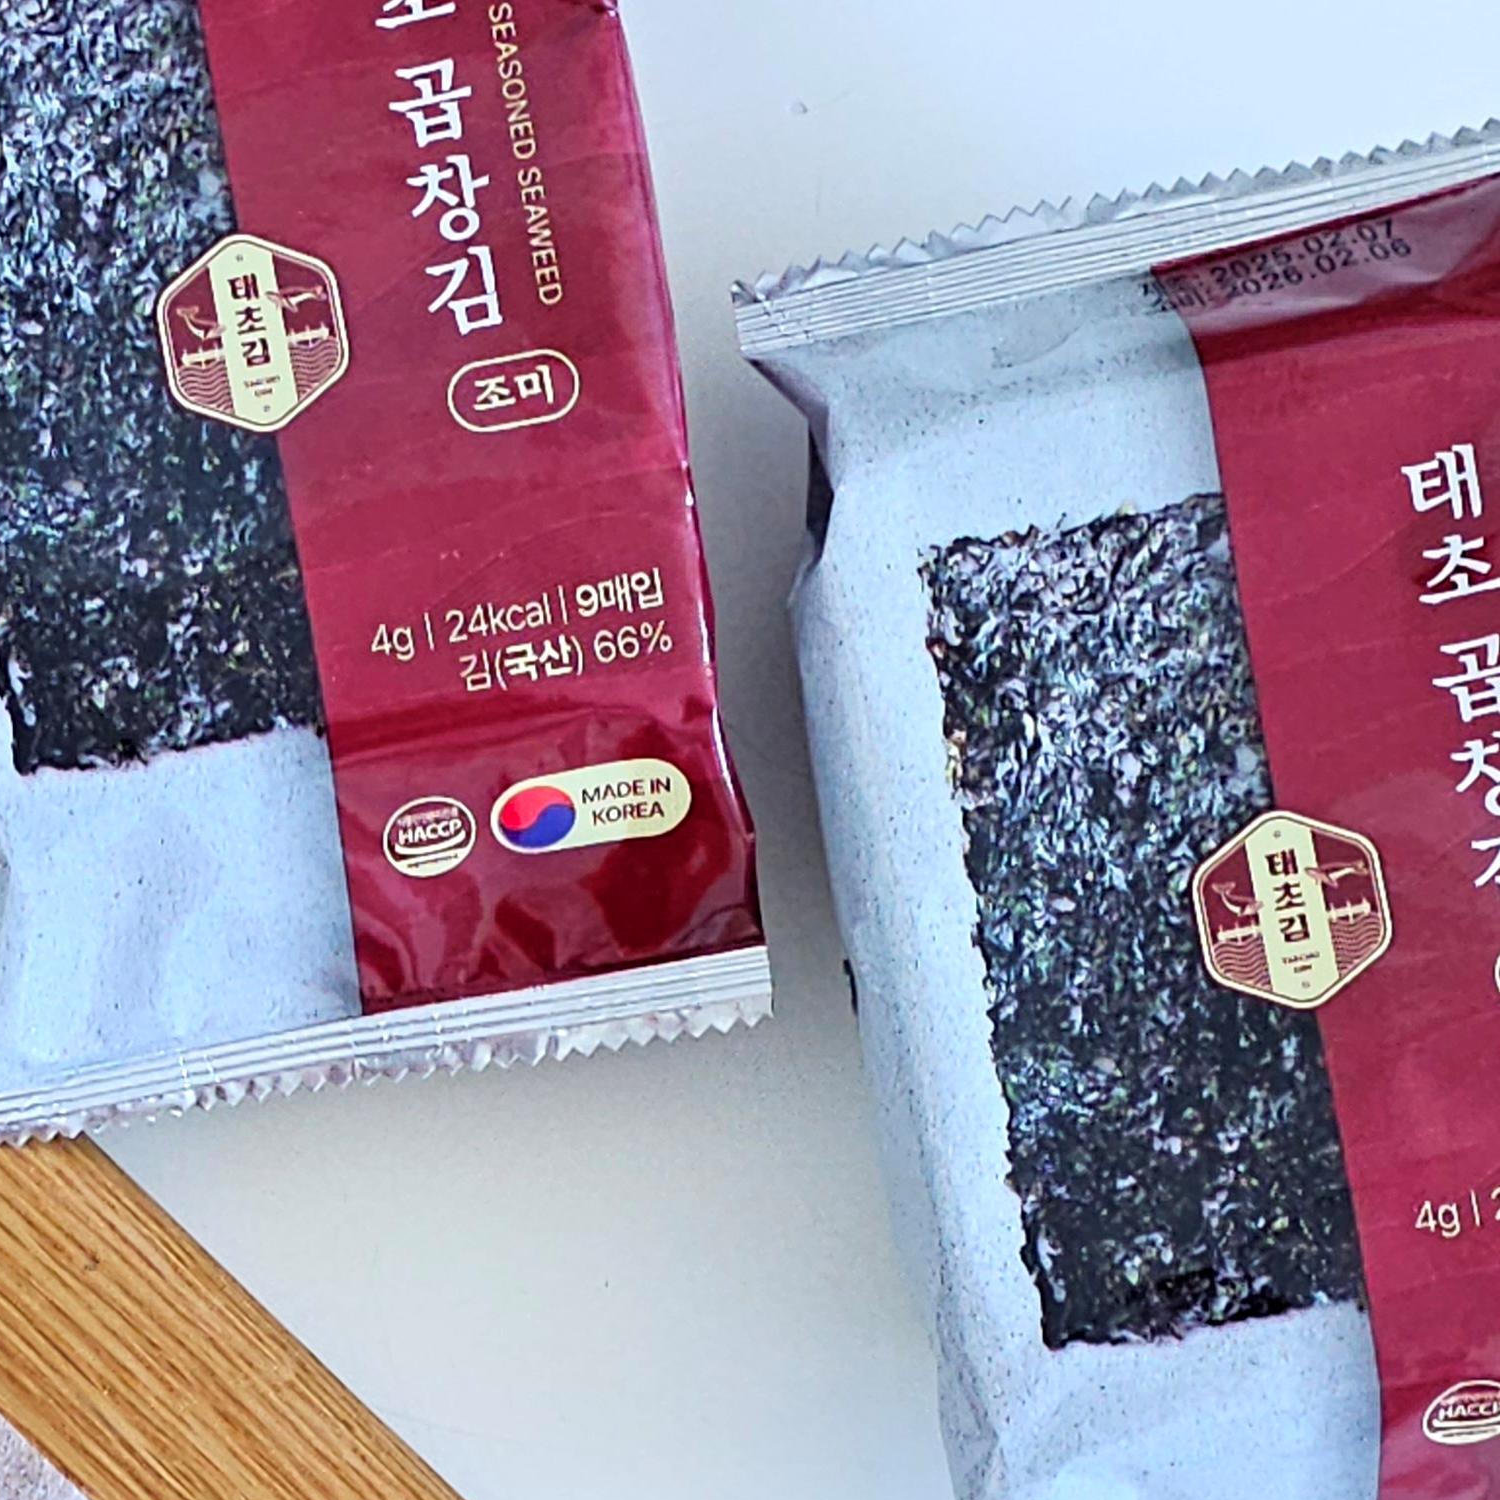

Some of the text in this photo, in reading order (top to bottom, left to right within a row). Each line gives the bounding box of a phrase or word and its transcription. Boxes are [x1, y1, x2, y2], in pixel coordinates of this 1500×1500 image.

[487, 2, 564, 306] SEASONED SEAWEED
[226, 272, 273, 368] 태초김
[472, 364, 556, 415] 조미
[370, 566, 665, 662] 4g 24kcal 9매입
[459, 619, 673, 692] 김(국산) 66%
[581, 776, 672, 804] MADE IN
[591, 801, 665, 826] KOREA
[398, 818, 463, 846] HACCP
[1264, 846, 1312, 945] 태초김
[1414, 1200, 1461, 1239] 4g
